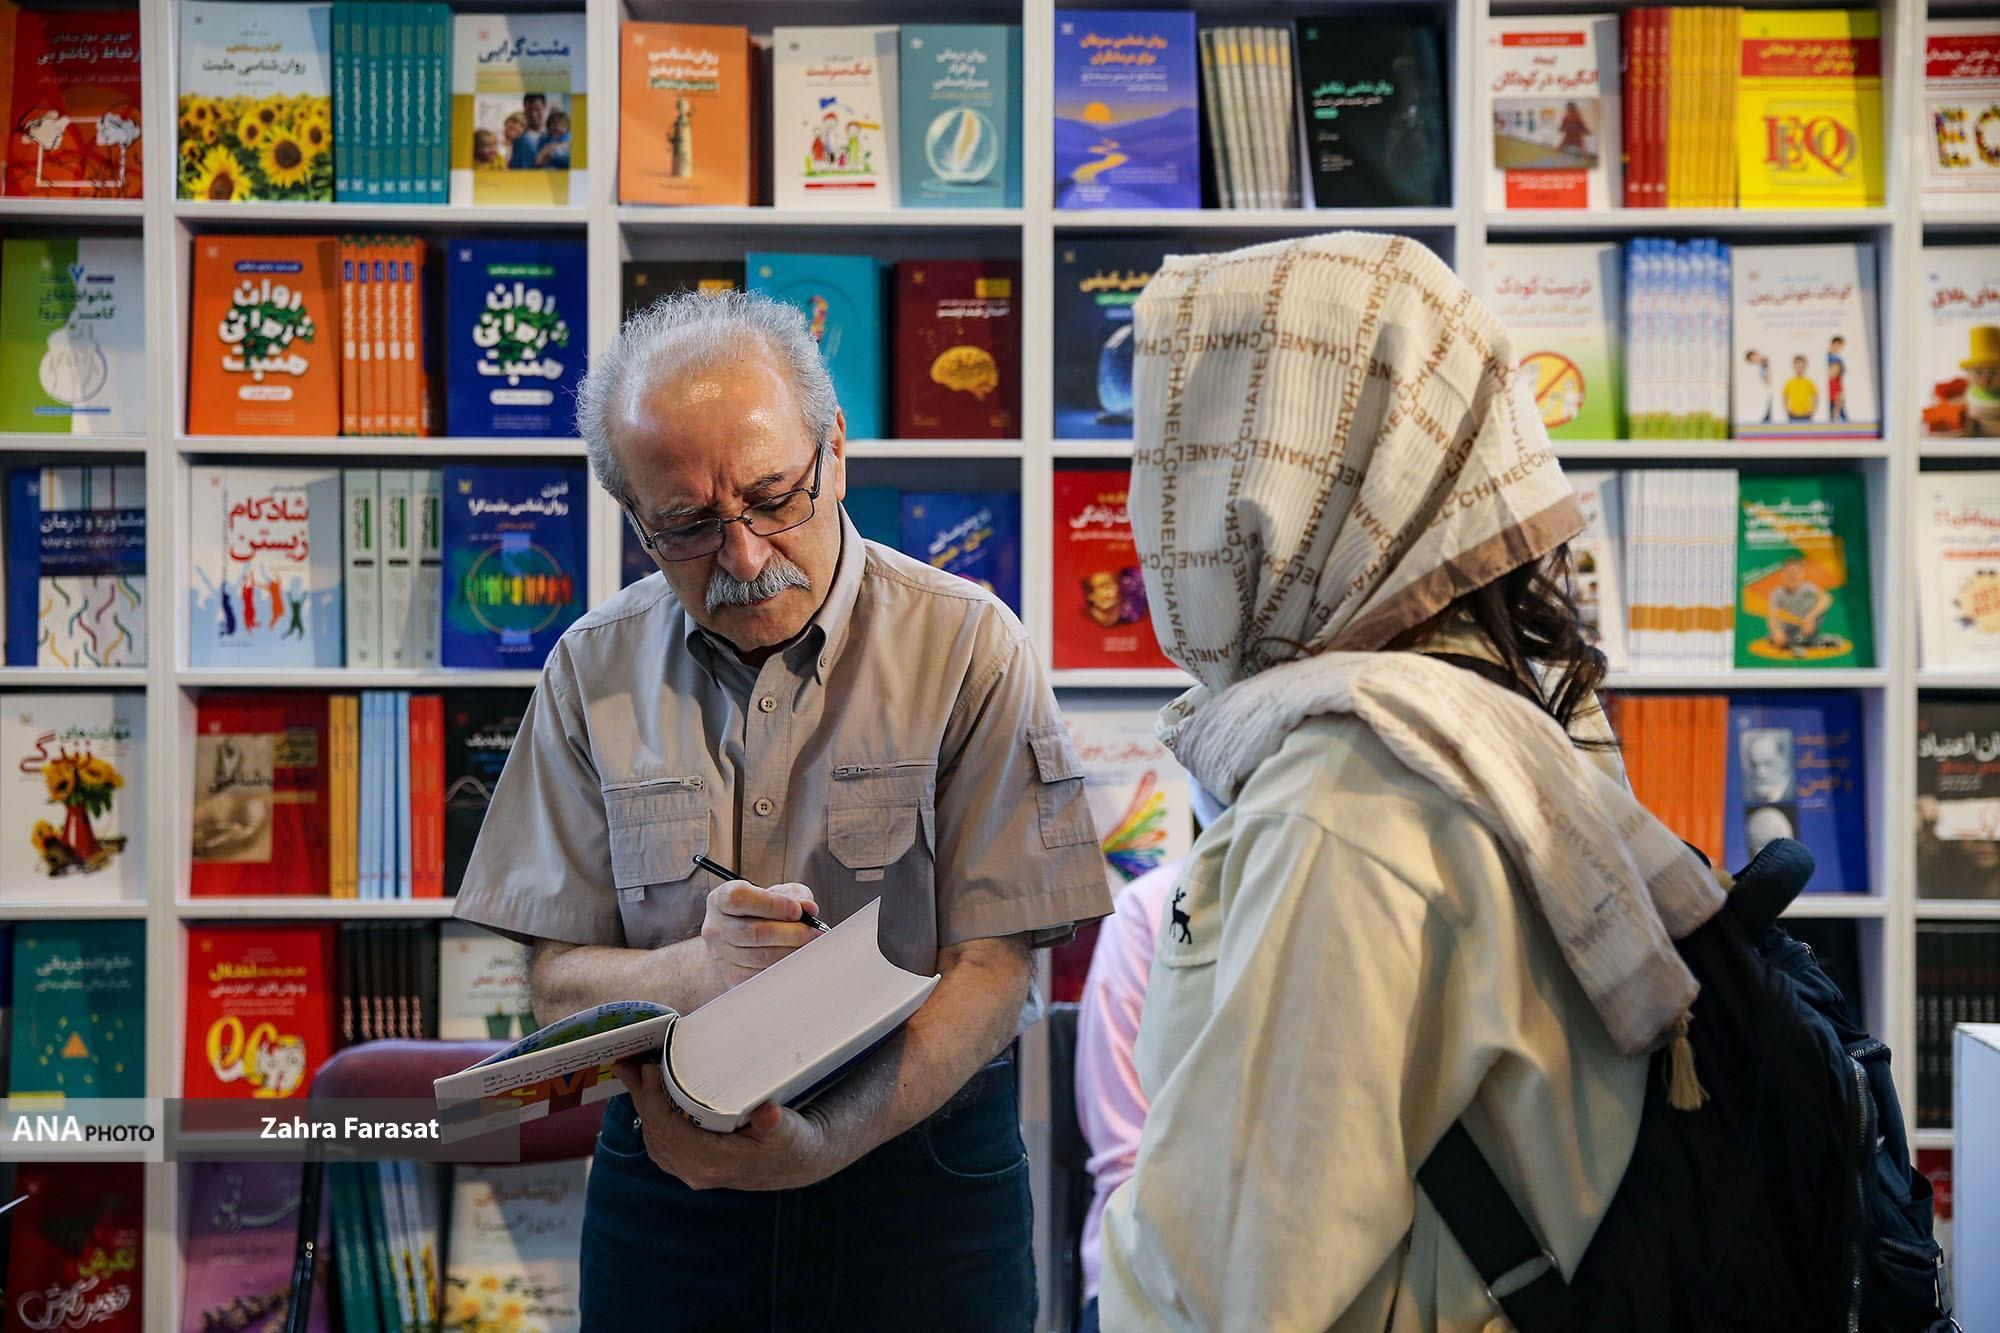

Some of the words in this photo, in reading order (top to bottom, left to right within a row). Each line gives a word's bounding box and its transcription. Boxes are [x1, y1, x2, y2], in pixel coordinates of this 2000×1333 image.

[1763, 114, 1850, 174] EQ
[233, 278, 303, 311] روان
[486, 280, 557, 314] روان
[1181, 331, 1263, 353] CHANEL
[1268, 331, 1352, 366] CHANEL
[221, 344, 309, 383] مثبت
[476, 346, 565, 387] مثبت
[1163, 349, 1186, 448] CHANEL
[1239, 344, 1272, 442] CHANEL
[1328, 364, 1364, 458] CHANEL
[1175, 441, 1242, 461] CHANEL
[1243, 440, 1332, 476] CHANEL
[230, 496, 309, 531] شادکام
[1161, 458, 1179, 557] CHANEL
[1225, 450, 1247, 547] CHANEL
[1292, 470, 1338, 567] CHANEL
[230, 528, 309, 562] زیستن
[1168, 547, 1235, 571] CHANEL
[1161, 565, 1189, 650] CHANEL
[1975, 731, 2000, 763] ان
